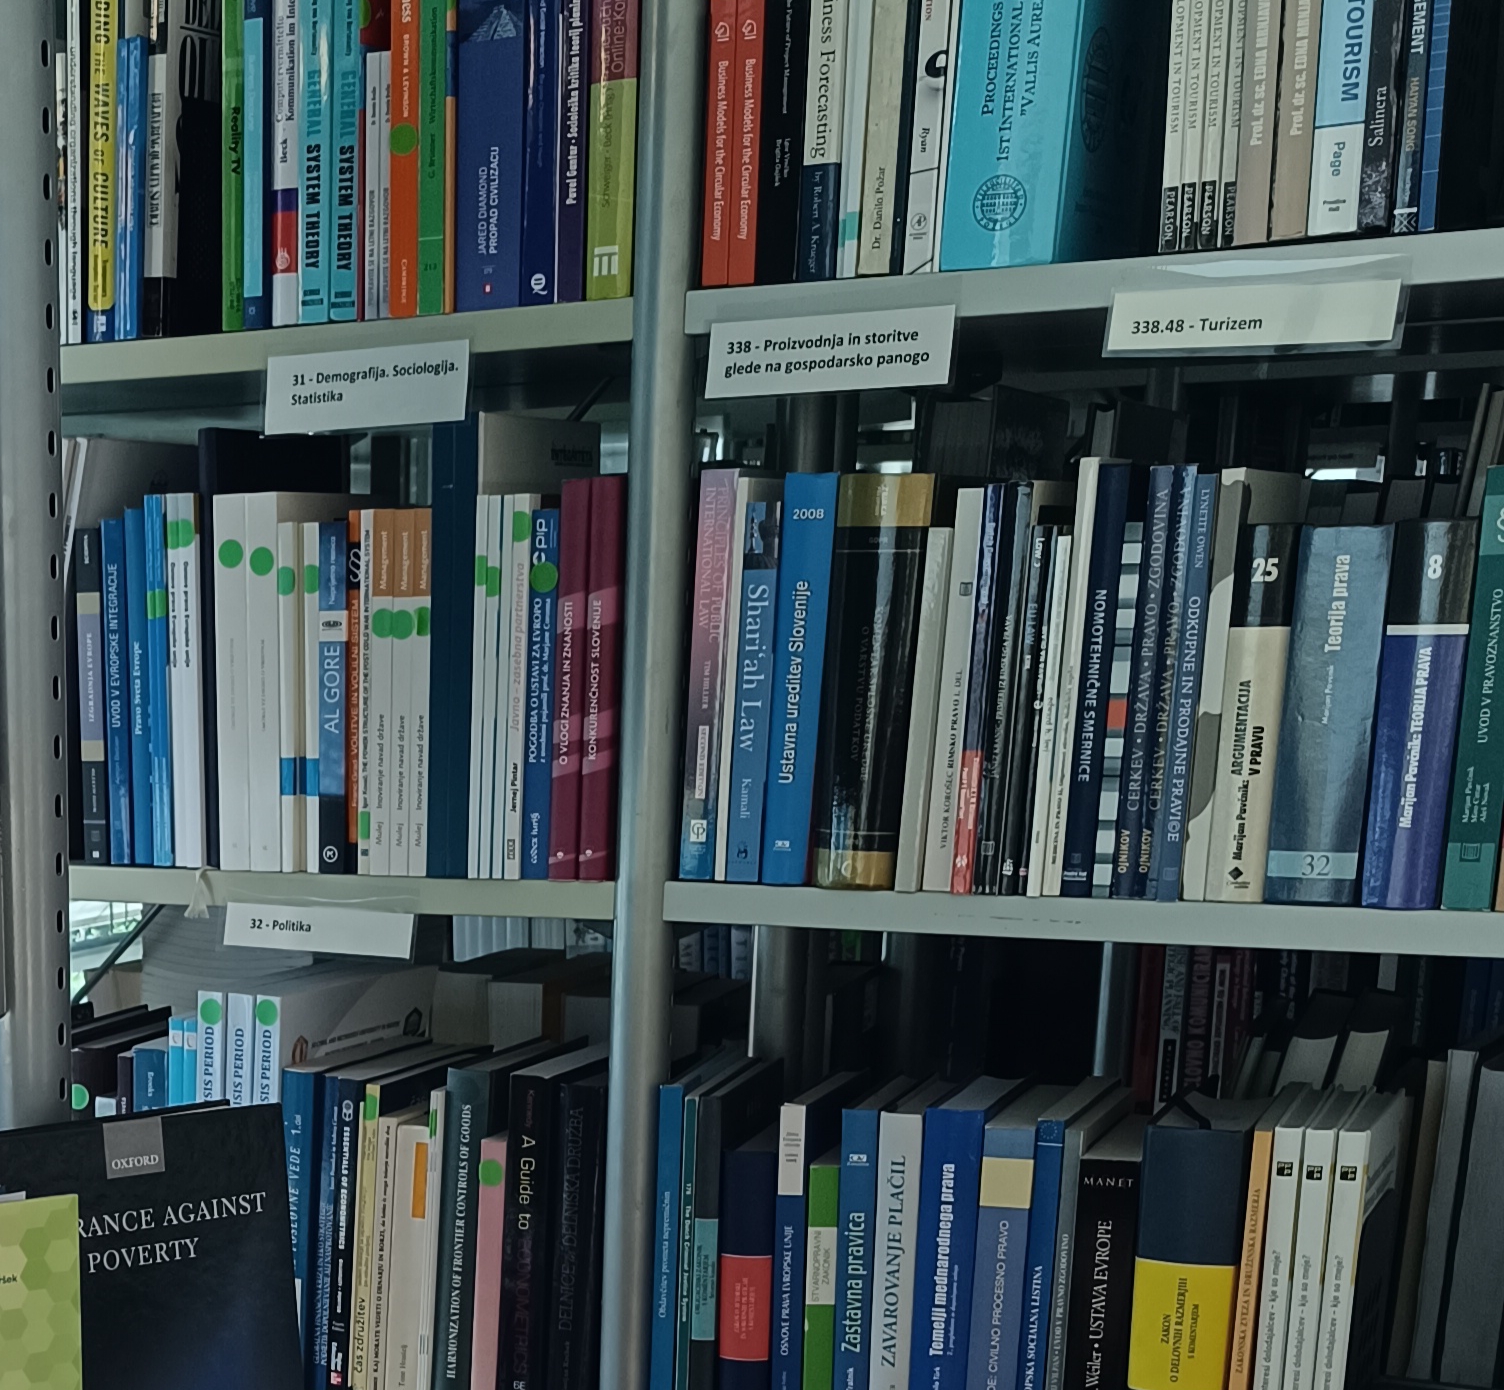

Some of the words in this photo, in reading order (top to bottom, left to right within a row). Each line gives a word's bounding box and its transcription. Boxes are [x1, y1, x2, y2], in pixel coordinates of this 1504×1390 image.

[230, 106, 242, 154] Reality
[230, 159, 242, 175] TV
[305, 144, 322, 206] SYSTEM
[477, 166, 488, 219] DIAMOND
[306, 210, 321, 269] THEORY
[477, 221, 488, 255] JARED
[727, 341, 749, 355] 338
[763, 335, 842, 356] Proizvodnja
[847, 331, 860, 346] in
[864, 328, 919, 346] storitve
[1132, 319, 1184, 336] 338.48
[1200, 315, 1263, 333] Turizem
[292, 373, 306, 386] 31
[316, 367, 389, 388] Demografija.
[392, 361, 459, 380] Sociologija.
[725, 362, 761, 380] glede
[764, 362, 781, 375] na
[785, 354, 873, 378] gospodarsko
[877, 351, 930, 371] panogo
[291, 390, 343, 406] Statistika
[792, 509, 824, 519] 2008
[1251, 558, 1279, 582] 25
[1427, 555, 1442, 579] 8
[789, 579, 811, 651] Slovenije
[324, 645, 340, 700] GORE
[785, 653, 800, 719] ureditev
[325, 705, 340, 734] AL
[739, 699, 762, 753] Law
[779, 722, 797, 784] Ustavna
[1301, 853, 1330, 876] 32
[250, 918, 263, 930] 32
[272, 919, 312, 933] Politika
[112, 1154, 159, 1170] OXFORD
[889, 1155, 906, 1229] PLAČIL
[1084, 1177, 1133, 1188] MANET
[87, 1238, 199, 1273] POVERTY
[845, 1212, 866, 1274] pravica
[841, 1278, 865, 1353] Zastavna
[881, 1234, 906, 1367] ZAVAROVANJE
